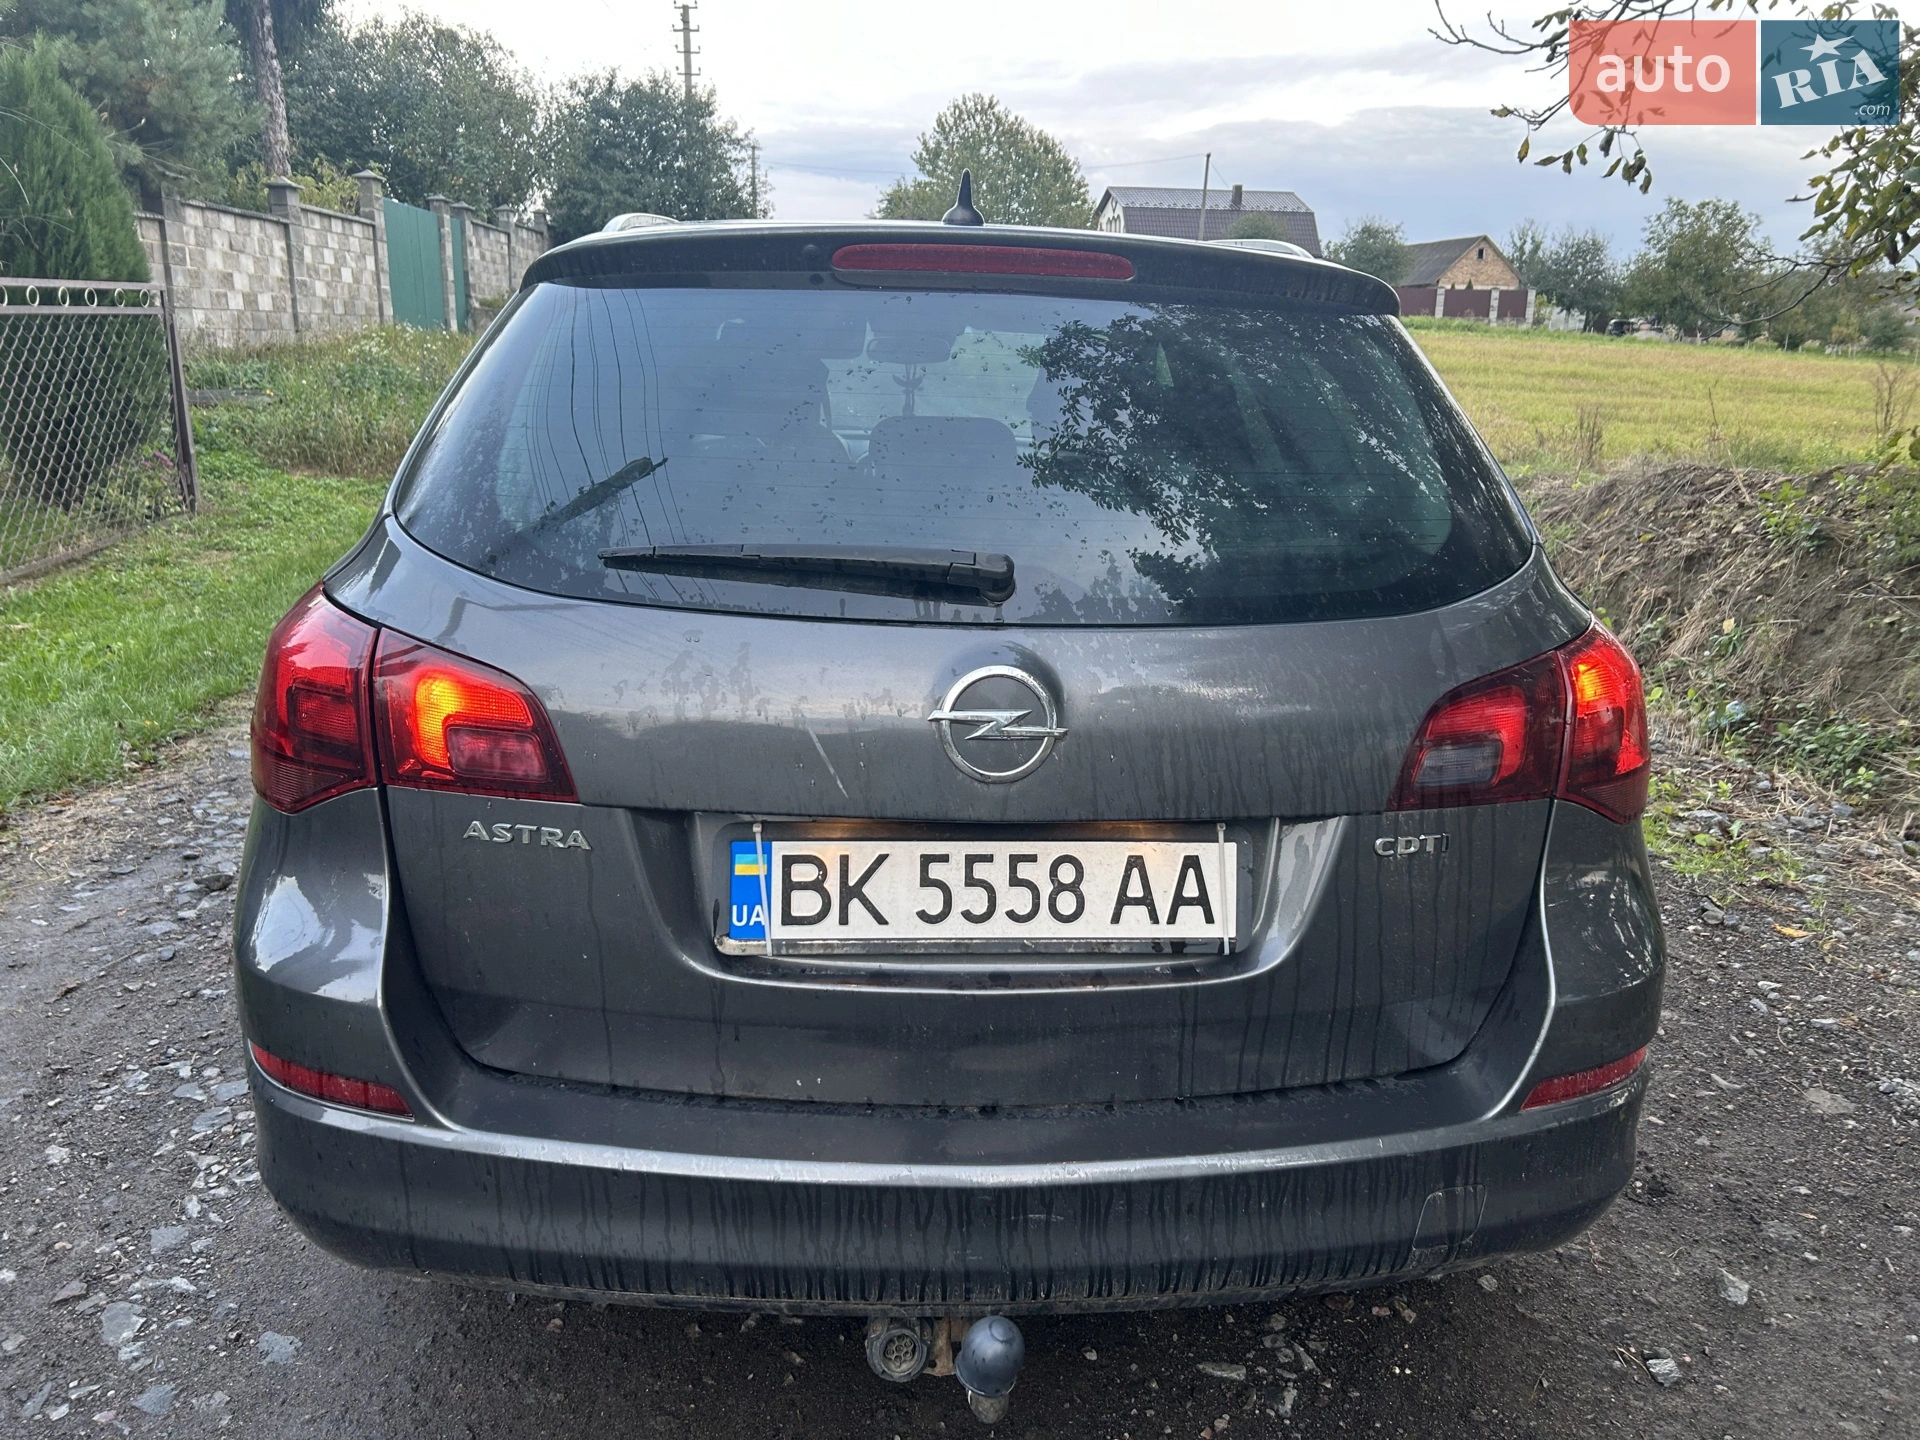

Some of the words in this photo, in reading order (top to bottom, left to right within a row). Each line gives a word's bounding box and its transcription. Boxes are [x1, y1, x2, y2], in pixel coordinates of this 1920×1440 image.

[462, 820, 592, 850] ASTRA
[1373, 832, 1450, 856] CDTI
[781, 853, 890, 926] BK
[915, 853, 1087, 925] 5558
[1110, 854, 1215, 925] AA
[732, 904, 766, 927] UA
